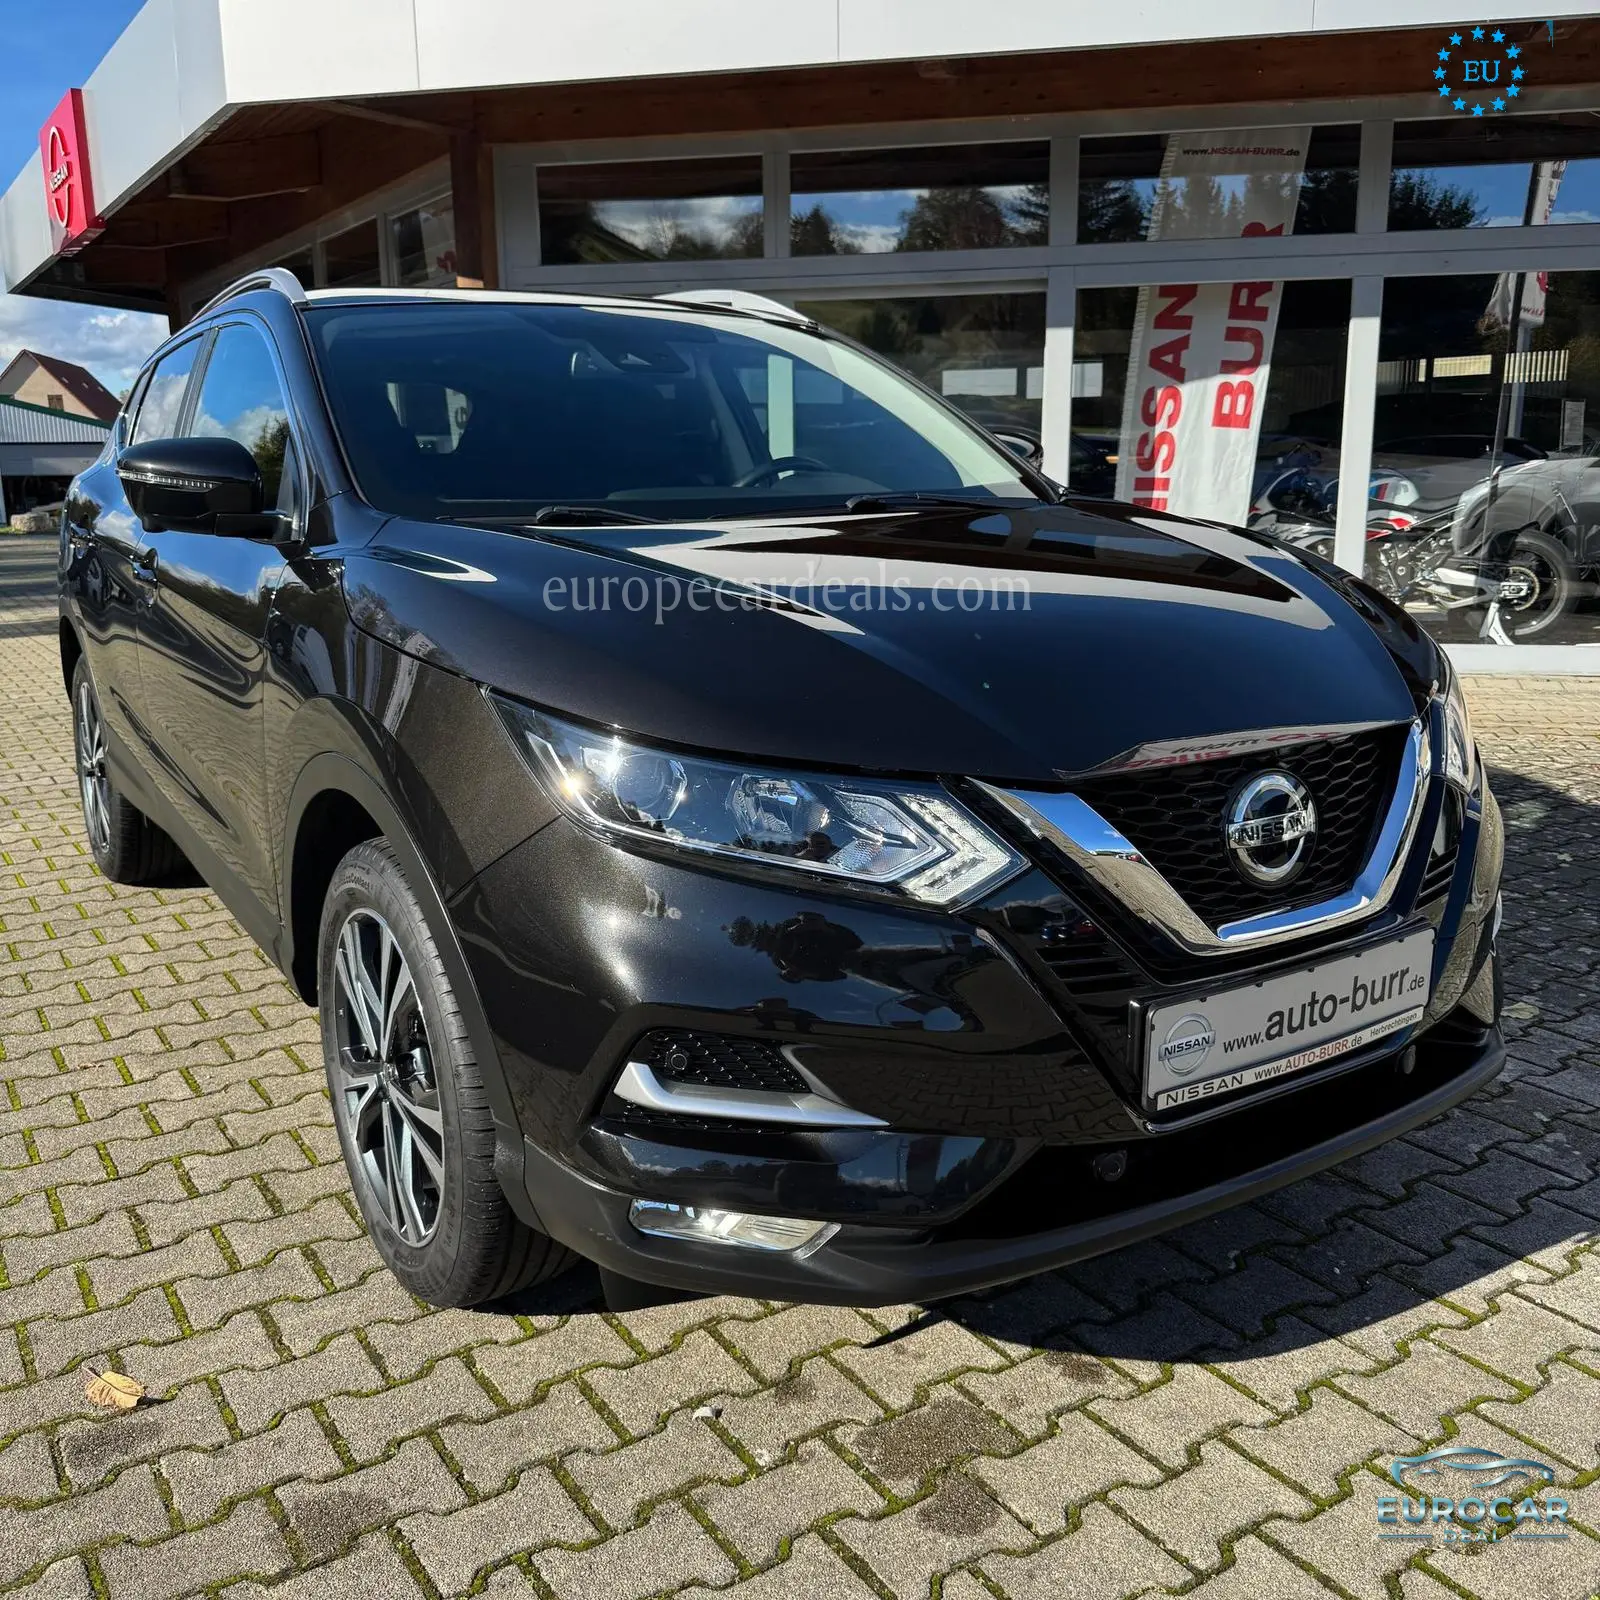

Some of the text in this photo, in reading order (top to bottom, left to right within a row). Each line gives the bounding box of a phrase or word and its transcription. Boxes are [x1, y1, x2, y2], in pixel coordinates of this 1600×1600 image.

[1182, 146, 1300, 157] www.NISSAN-BURR.de
[1132, 282, 1198, 512] ISSAN
[1236, 811, 1307, 842] NISSAN
[1223, 966, 1425, 1054] www.auto-burr.de
[1163, 1035, 1211, 1056] NISSAN
[1166, 1012, 1417, 1106] NISSAN www.AUTO-BURR.de Herbrechtingen
